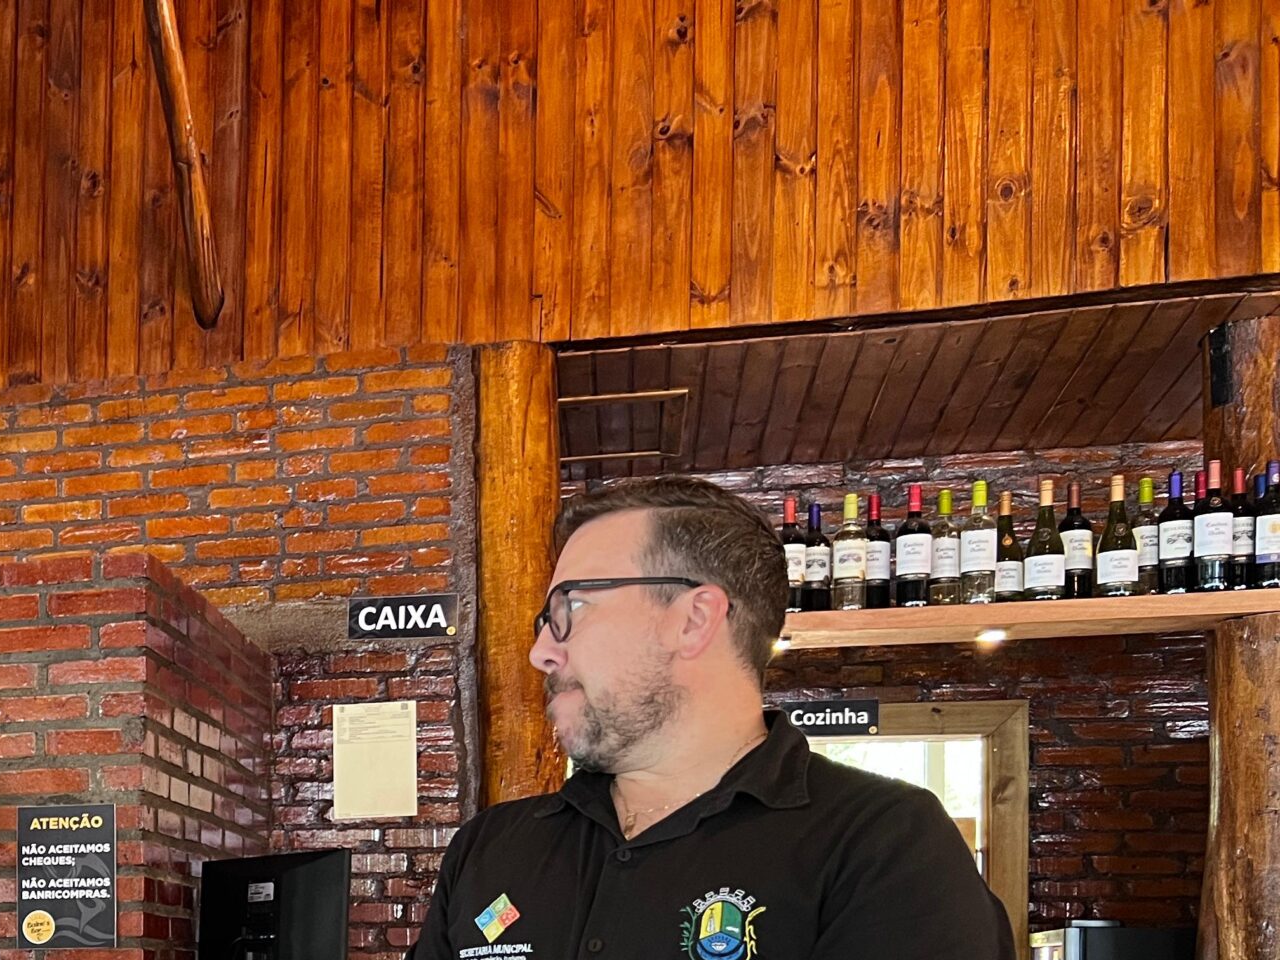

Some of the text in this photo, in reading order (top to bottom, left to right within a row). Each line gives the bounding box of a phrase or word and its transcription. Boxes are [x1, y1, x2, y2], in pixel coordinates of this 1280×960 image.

[358, 603, 447, 631] CAIXA
[790, 707, 868, 726] Cozinha
[30, 813, 103, 830] ATENÇÃO
[21, 843, 111, 855] NÃO ACEITAMOS
[21, 856, 76, 867] CHEQUES;
[21, 877, 111, 889] NÃO ACEITAMOS
[21, 889, 111, 900] BANRICOMPRAS.
[492, 943, 534, 954] MUNICIPAL
